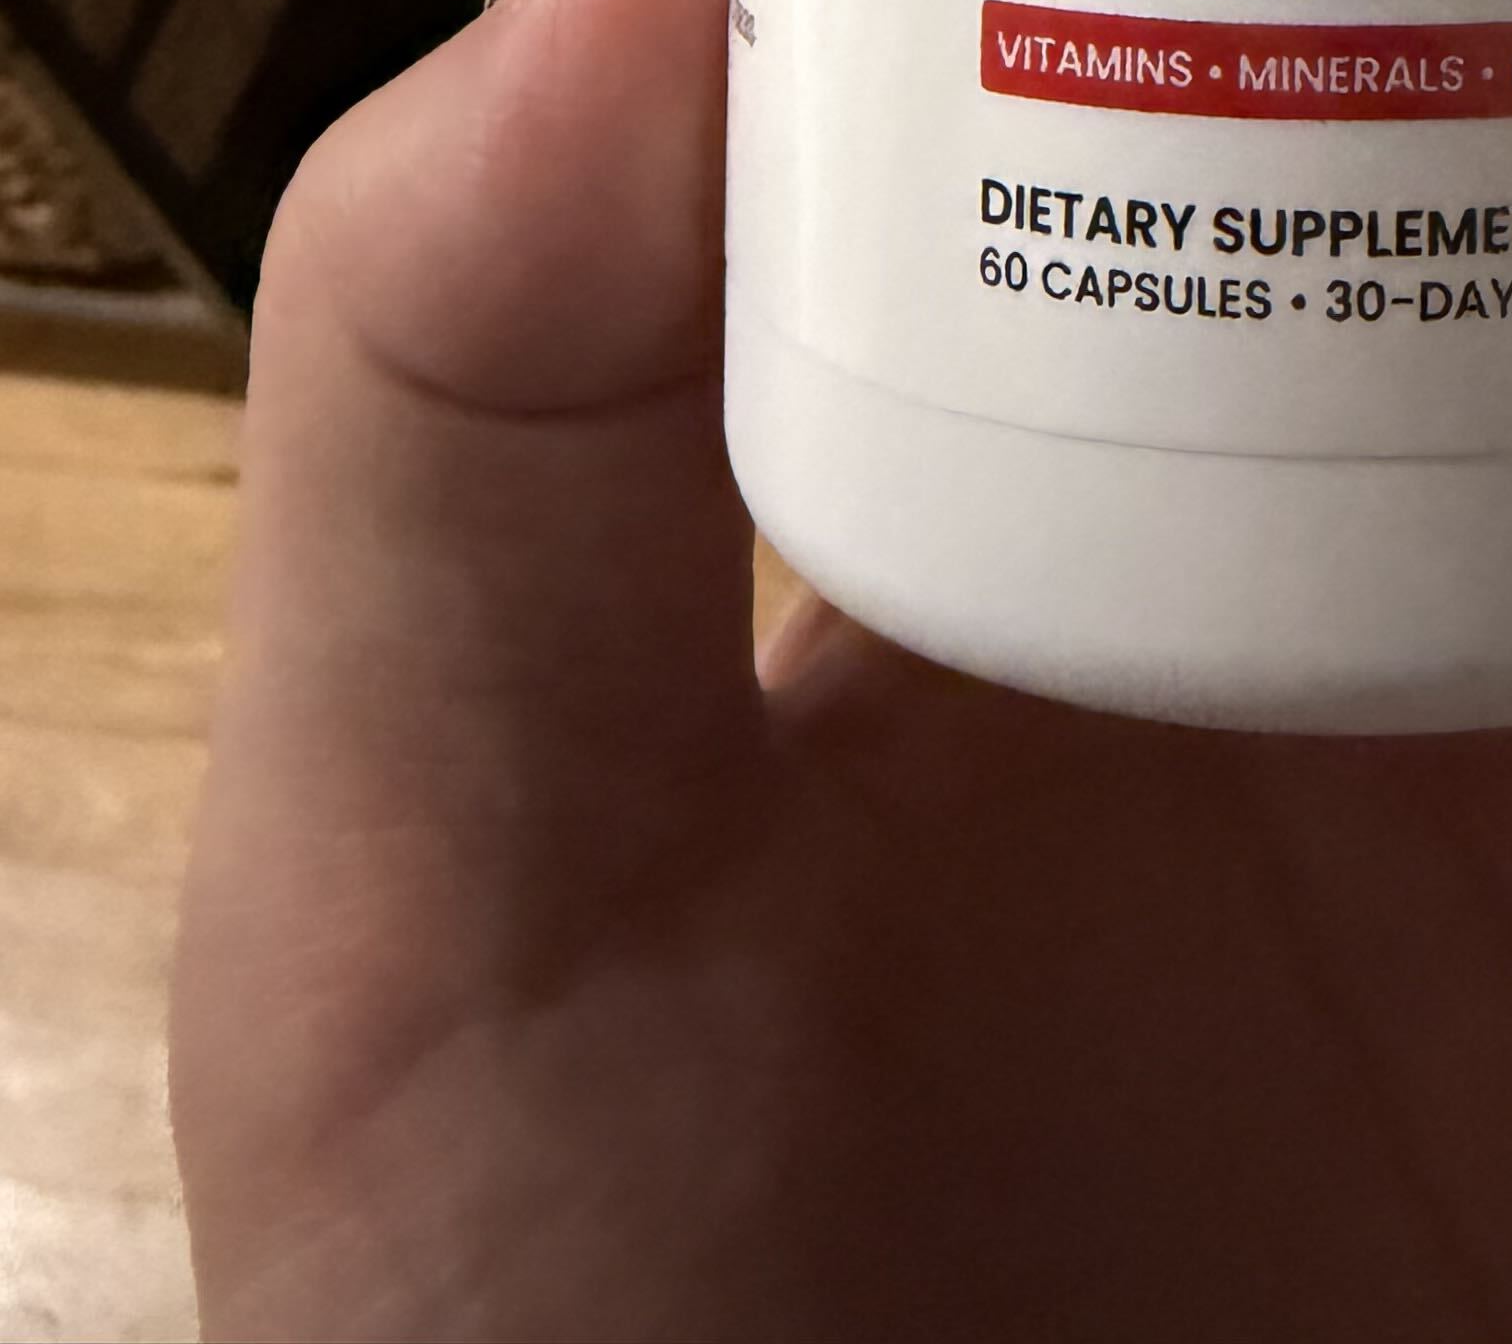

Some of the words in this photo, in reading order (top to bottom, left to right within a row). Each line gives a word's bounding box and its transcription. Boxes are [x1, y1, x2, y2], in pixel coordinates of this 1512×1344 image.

[997, 30, 1193, 88] VITAMINS
[1238, 54, 1465, 95] MINERALS
[981, 178, 1196, 252] DIETARY
[979, 247, 1029, 292] 60
[1041, 261, 1273, 321] CAPSULES
